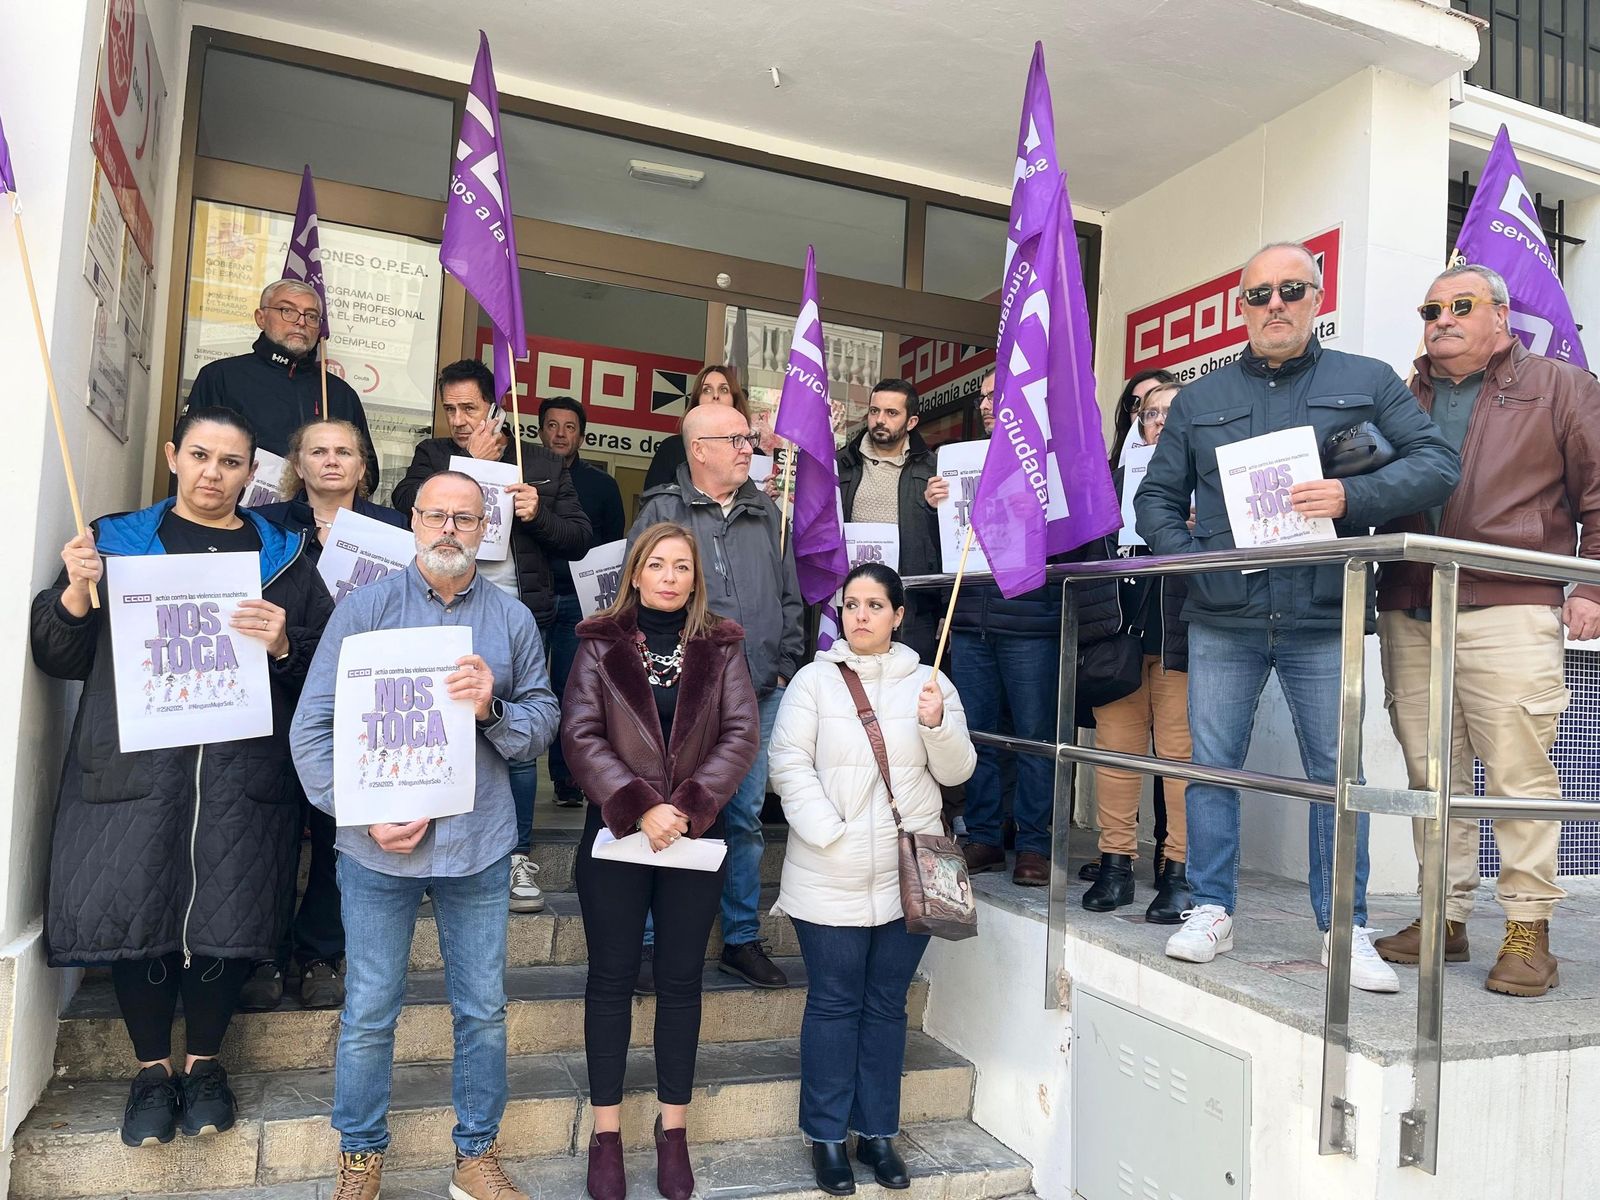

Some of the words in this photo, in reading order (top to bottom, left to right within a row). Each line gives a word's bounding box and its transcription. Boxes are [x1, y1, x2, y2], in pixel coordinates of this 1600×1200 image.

[451, 174, 477, 205] ios
[475, 206, 491, 221] a
[489, 221, 506, 243] la
[206, 258, 252, 272] GOBIERNO
[1489, 219, 1564, 289] servicio
[219, 269, 252, 281] ESPAÑA
[370, 257, 429, 278] O.P.E.A.
[325, 285, 374, 300] OGRAMA
[376, 293, 391, 303] DE
[325, 296, 350, 309] CIÓN
[353, 301, 425, 321] PROFESIONAL
[337, 311, 350, 321] EL
[353, 314, 396, 328] EMPLEO
[347, 325, 354, 333] Y
[329, 334, 386, 350] TOEMPLEO
[898, 339, 955, 385] COO
[1174, 367, 1196, 382] nes
[1200, 352, 1243, 375] obrer
[481, 343, 637, 411] COO
[918, 383, 960, 413] dadanía
[963, 369, 989, 395] ceu
[585, 432, 632, 450] eras
[1249, 463, 1293, 495] NOS
[247, 485, 281, 506] NO
[1246, 488, 1292, 521] TOC
[336, 540, 358, 552] CCOO
[856, 544, 882, 561] NOS
[349, 556, 400, 585] NO
[597, 570, 623, 594] NO
[124, 595, 151, 603] CCOO
[156, 601, 221, 638] NOS
[145, 635, 239, 676] TOCA
[348, 668, 371, 678] CCOO
[375, 676, 434, 712] NOS
[361, 710, 448, 751] TOCA
